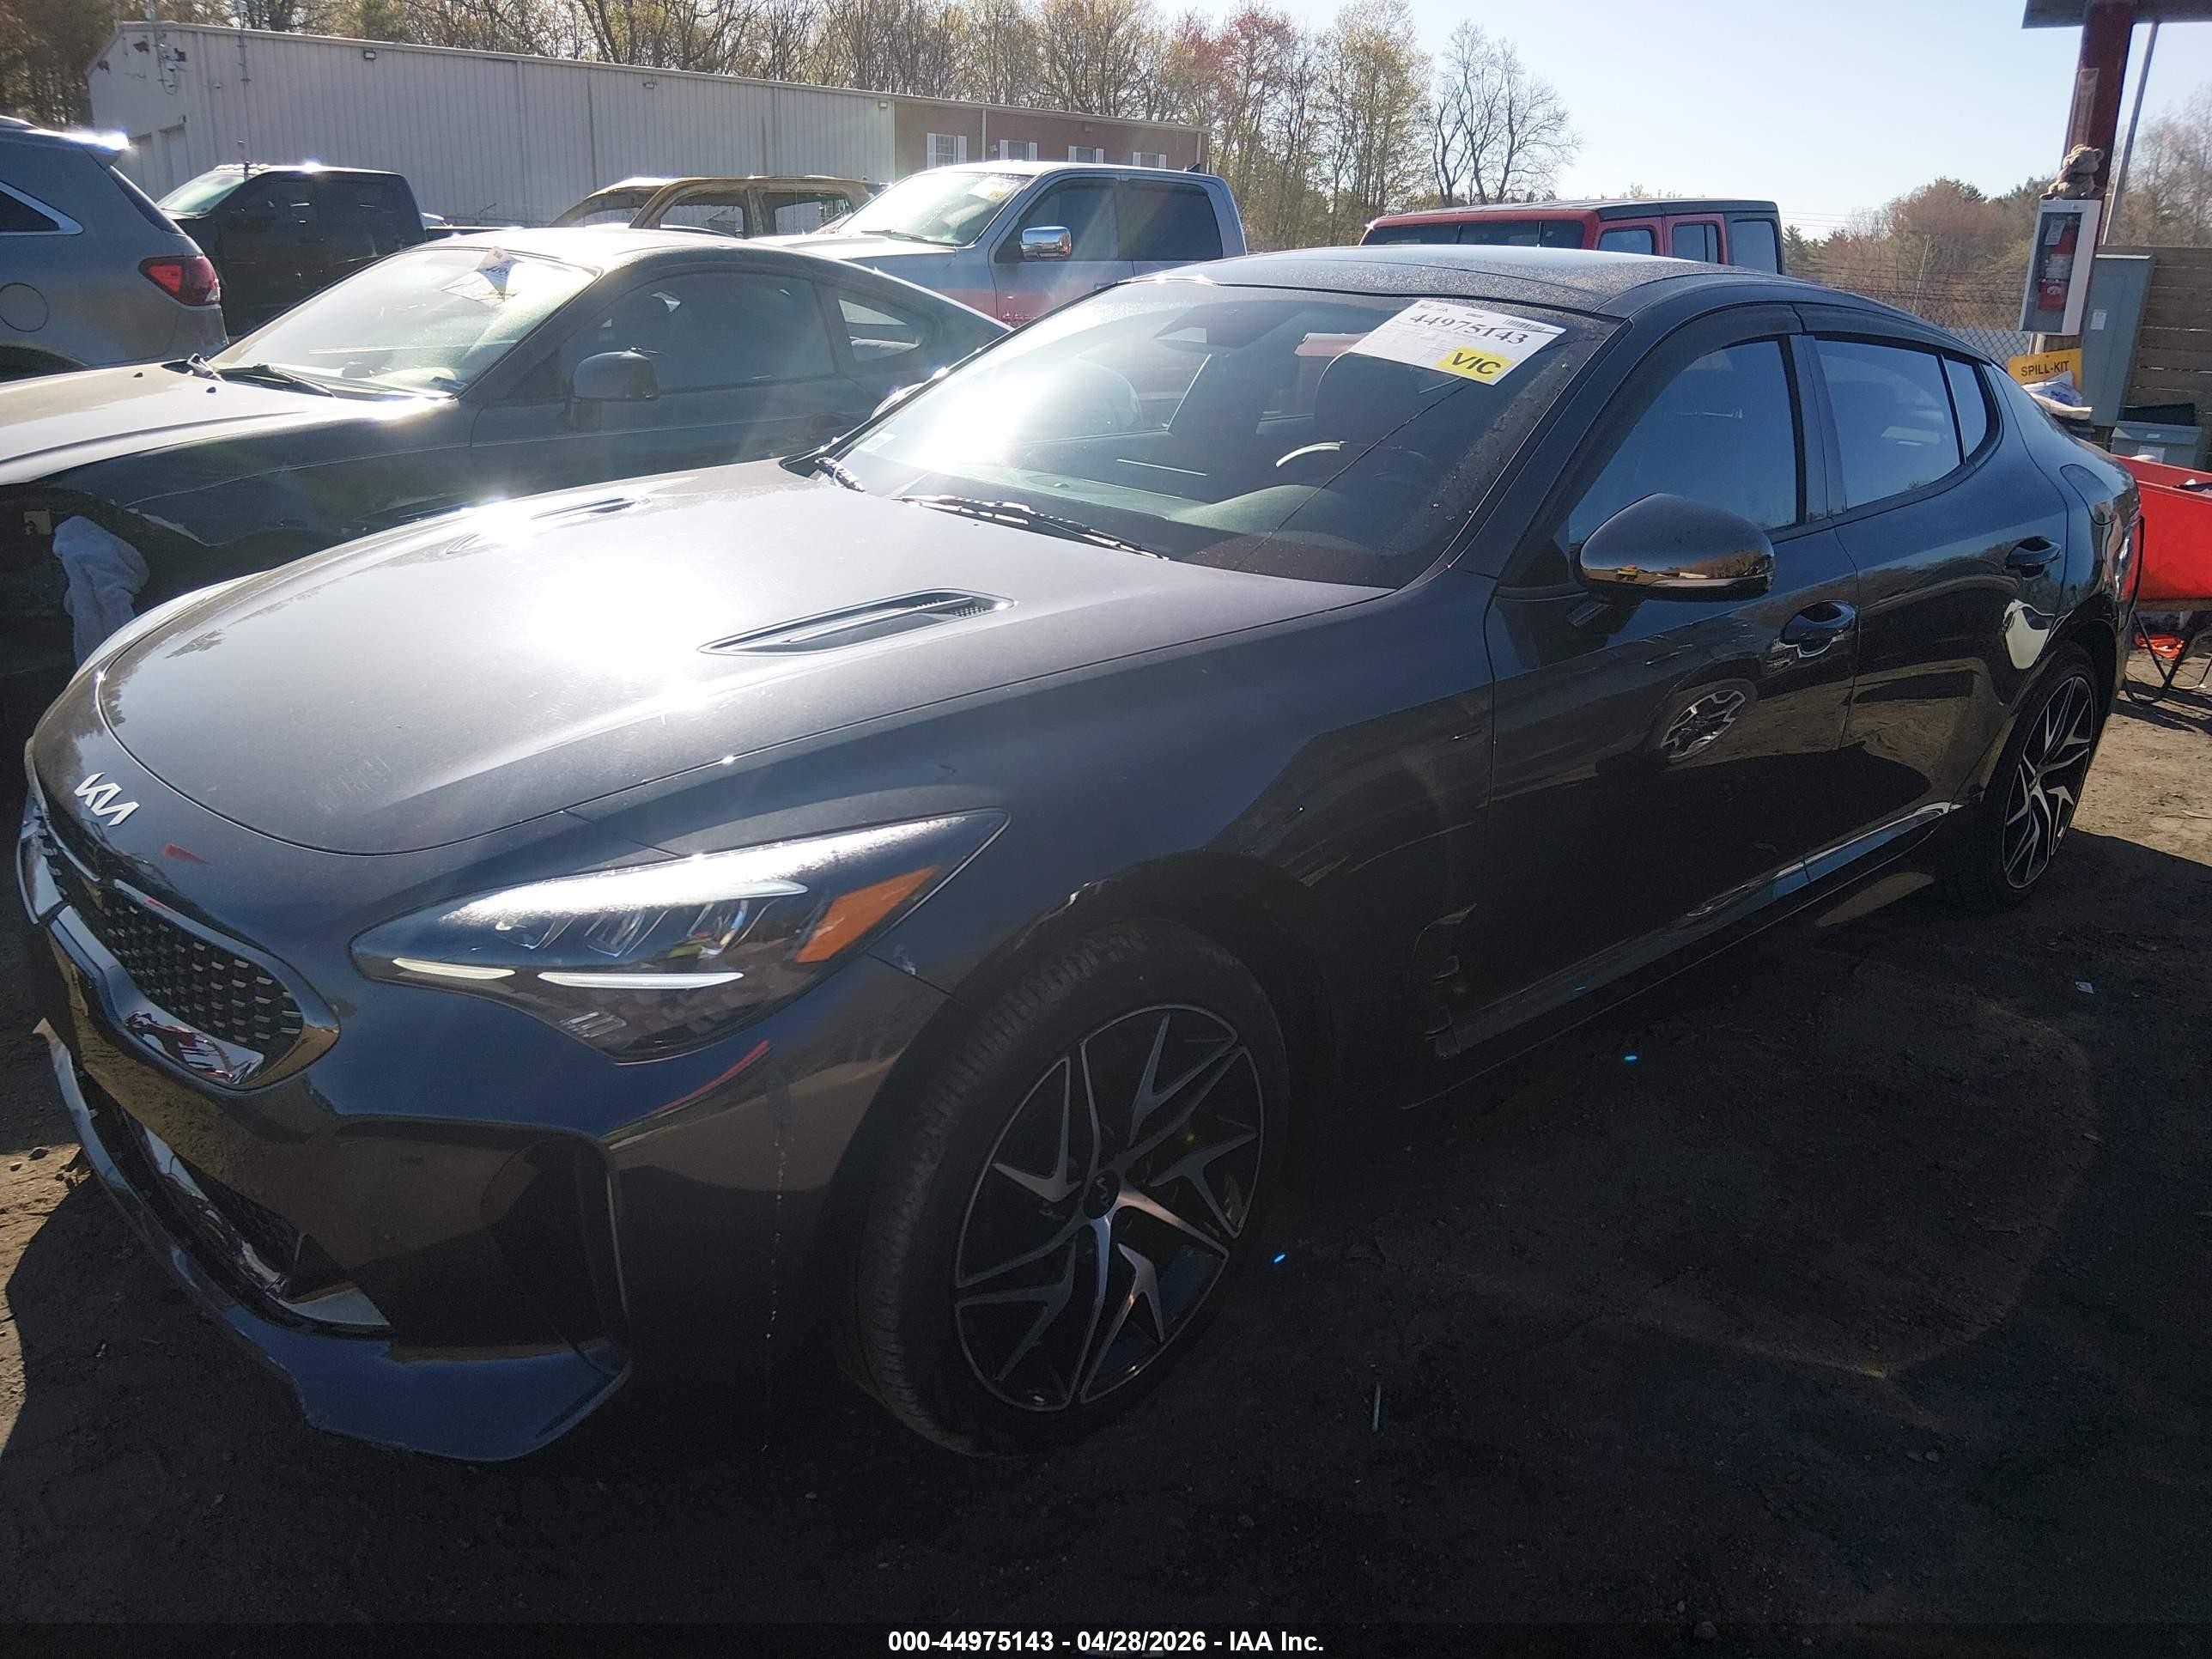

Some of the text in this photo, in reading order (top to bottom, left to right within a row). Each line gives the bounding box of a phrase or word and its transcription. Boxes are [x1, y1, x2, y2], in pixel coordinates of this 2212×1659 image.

[1409, 313, 1529, 344] 44975143
[1451, 352, 1501, 375] VIC
[2021, 361, 2070, 377] SPILL-KIT
[74, 772, 140, 826] KIA
